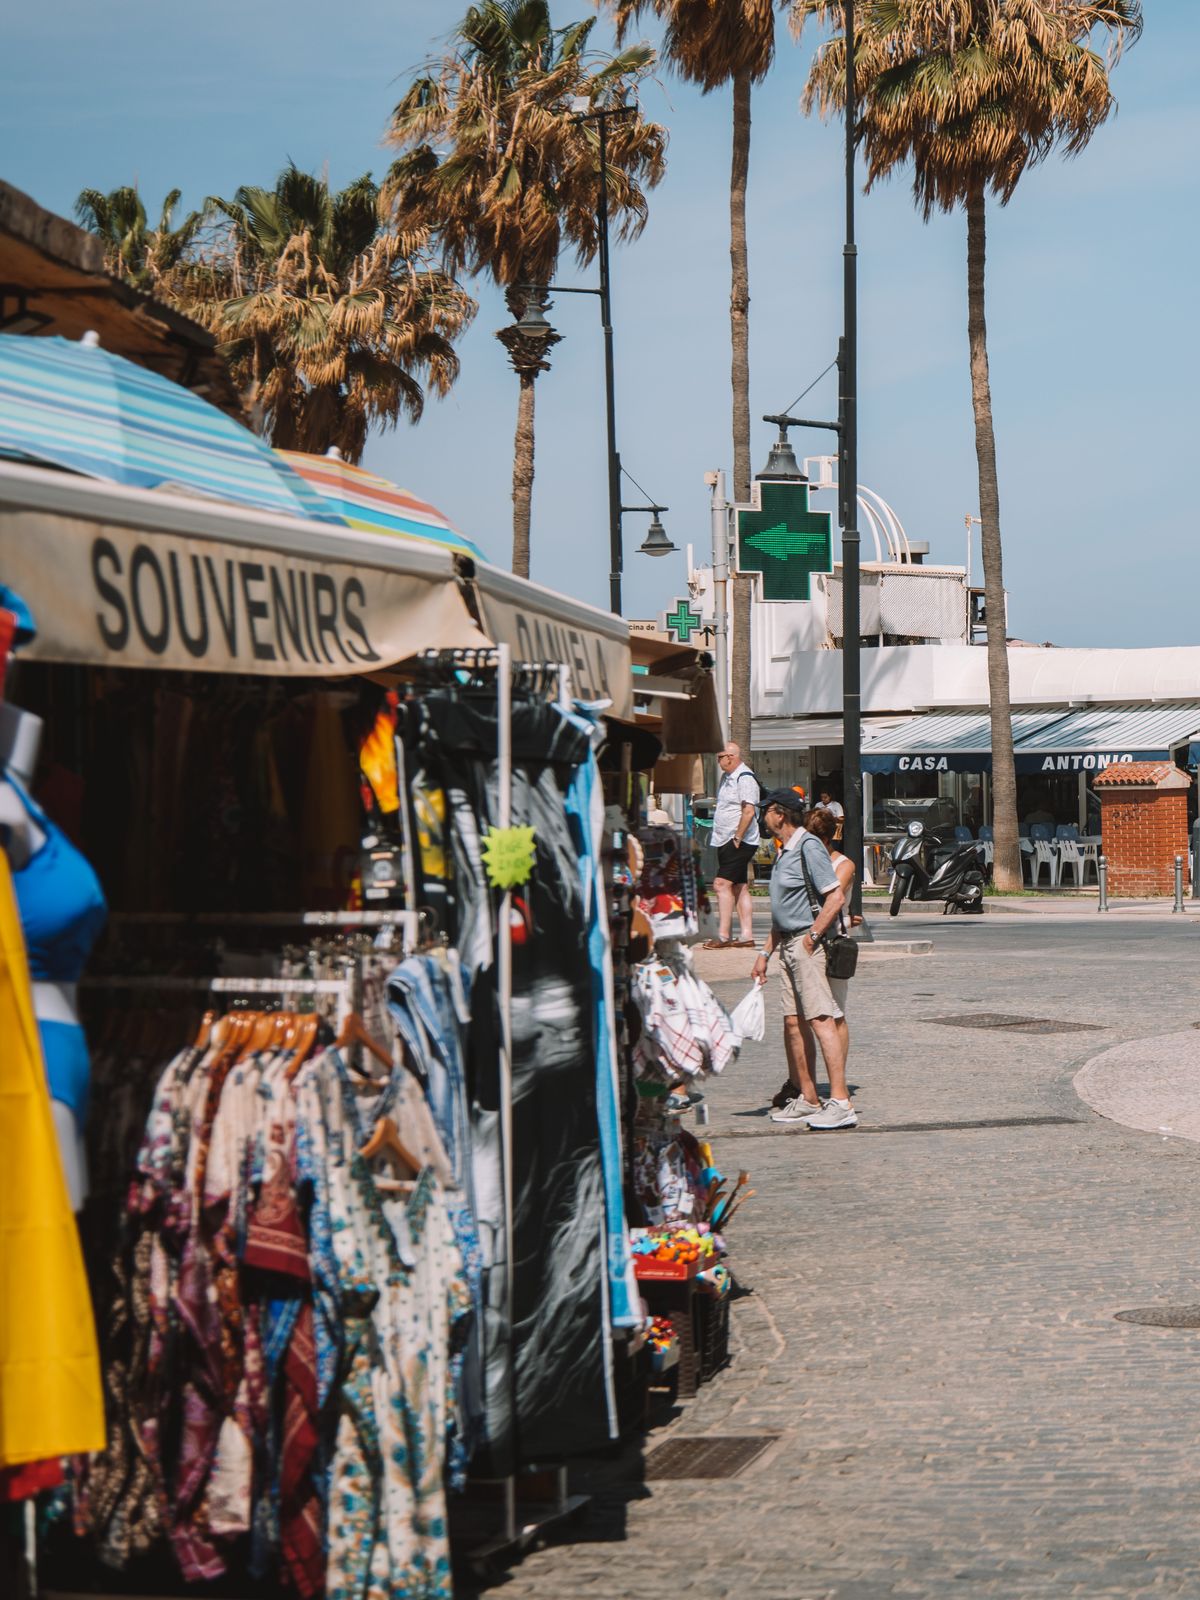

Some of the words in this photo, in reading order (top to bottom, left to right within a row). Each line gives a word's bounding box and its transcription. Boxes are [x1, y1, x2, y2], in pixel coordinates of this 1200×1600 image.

[91, 537, 382, 664] SOUVENIRS
[898, 756, 948, 770] CASA
[1041, 753, 1133, 771] ANTONIO
